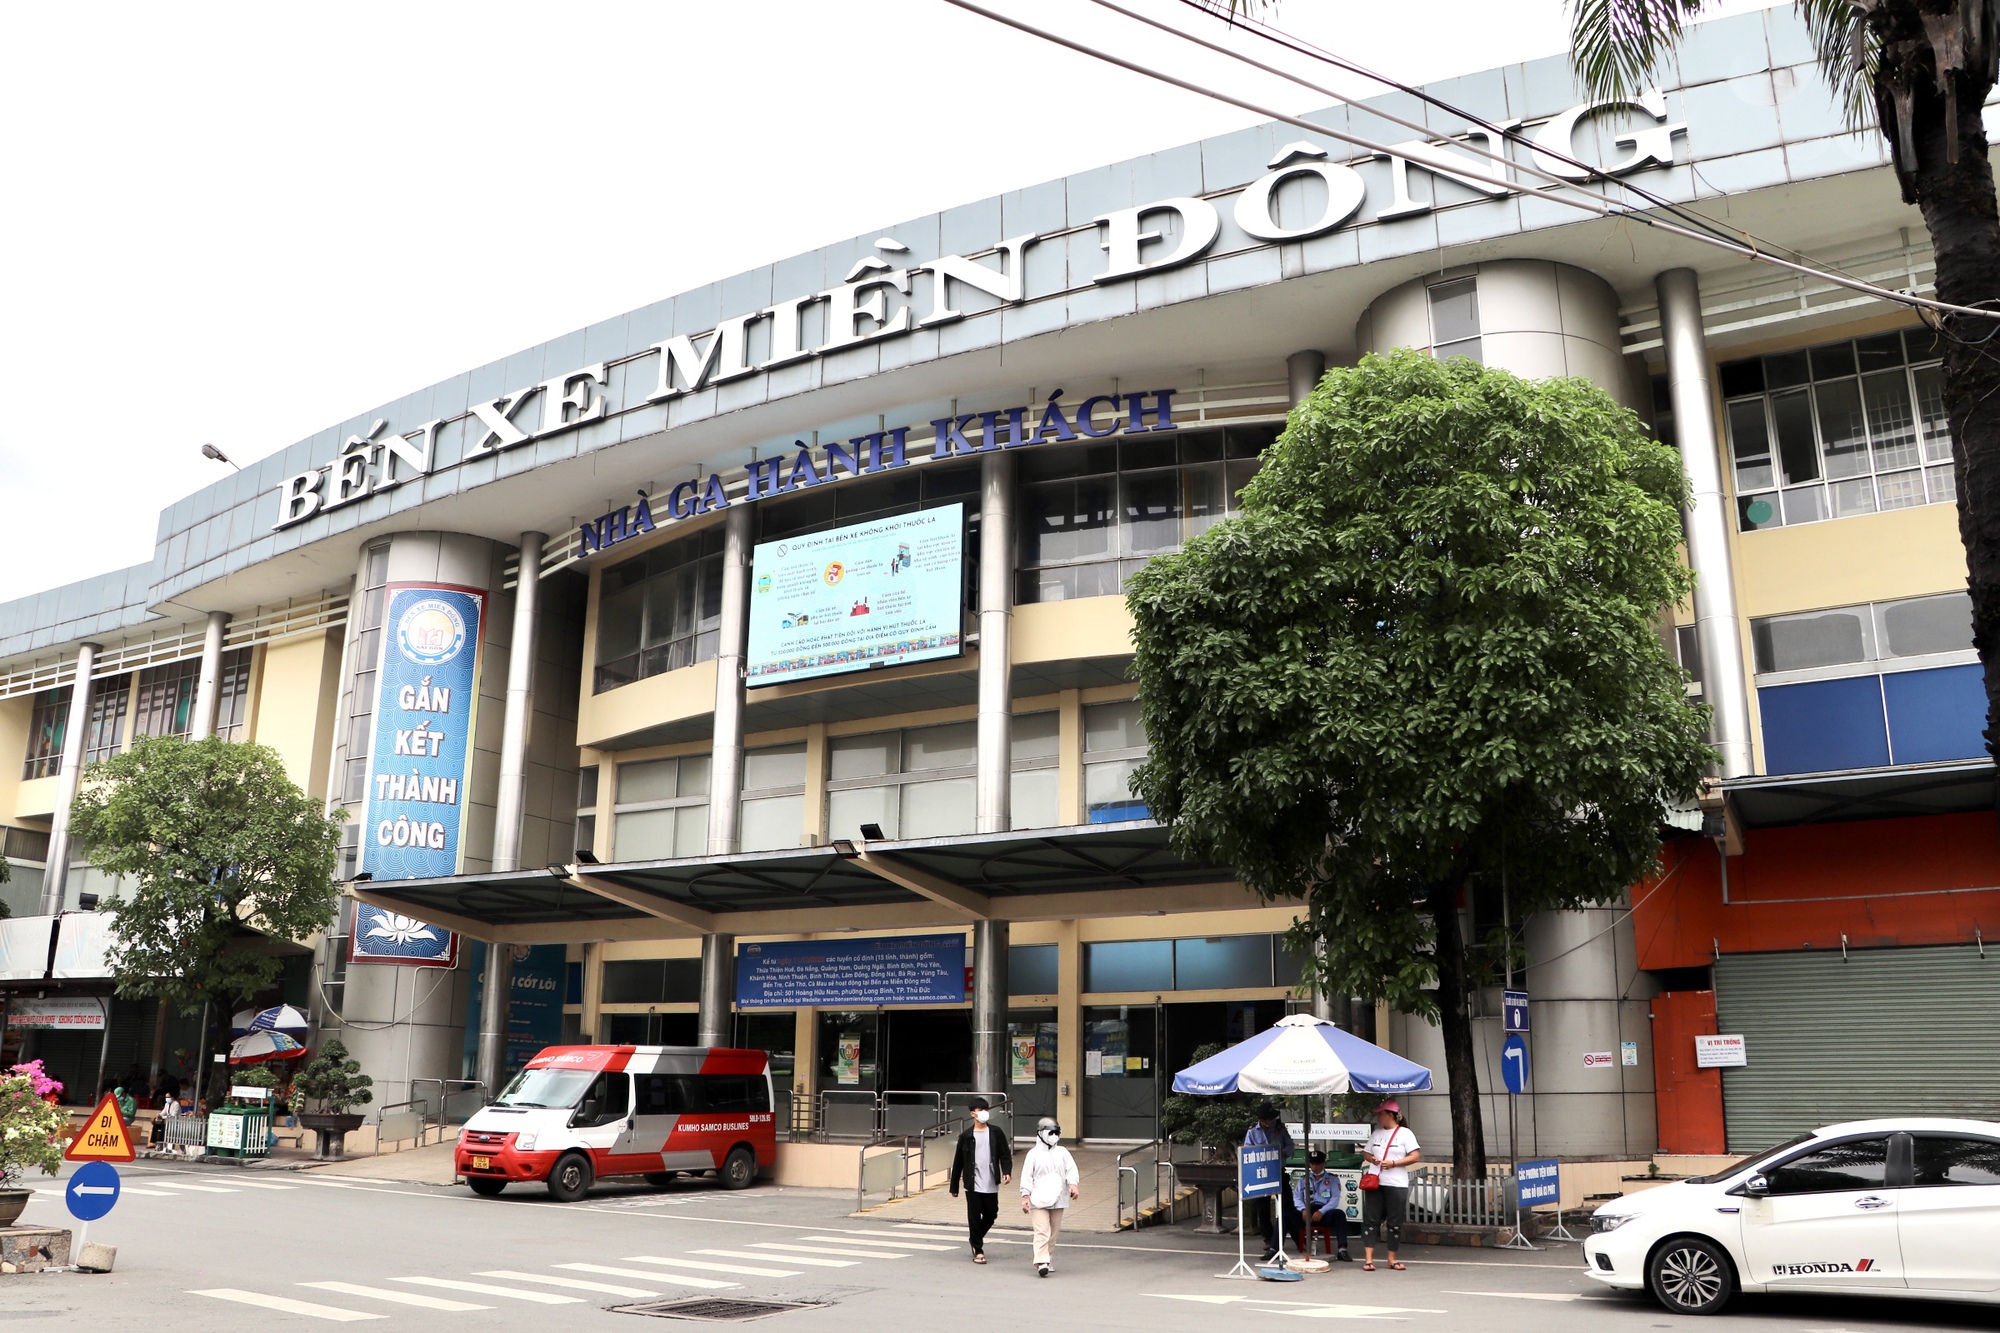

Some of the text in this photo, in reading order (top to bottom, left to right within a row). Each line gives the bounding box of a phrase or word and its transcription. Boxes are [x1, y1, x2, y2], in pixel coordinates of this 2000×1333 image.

[272, 87, 1690, 531] BẾN XE MIỀN ĐÔNG
[578, 388, 1178, 558] NHÀ GA HÀNH KHÁCH
[398, 675, 450, 713] GẮN
[395, 720, 444, 757] KẾT
[376, 768, 458, 804] THÀNH
[377, 815, 446, 849] CÔNG
[517, 973, 539, 989] CỐT
[554, 1055, 584, 1063] SAMCO
[100, 1116, 112, 1127] ĐI
[677, 1122, 750, 1132] KUMHO SAMCO BUSLINES
[87, 1133, 119, 1150] CHẬM
[1788, 1263, 1854, 1275] HONDA
